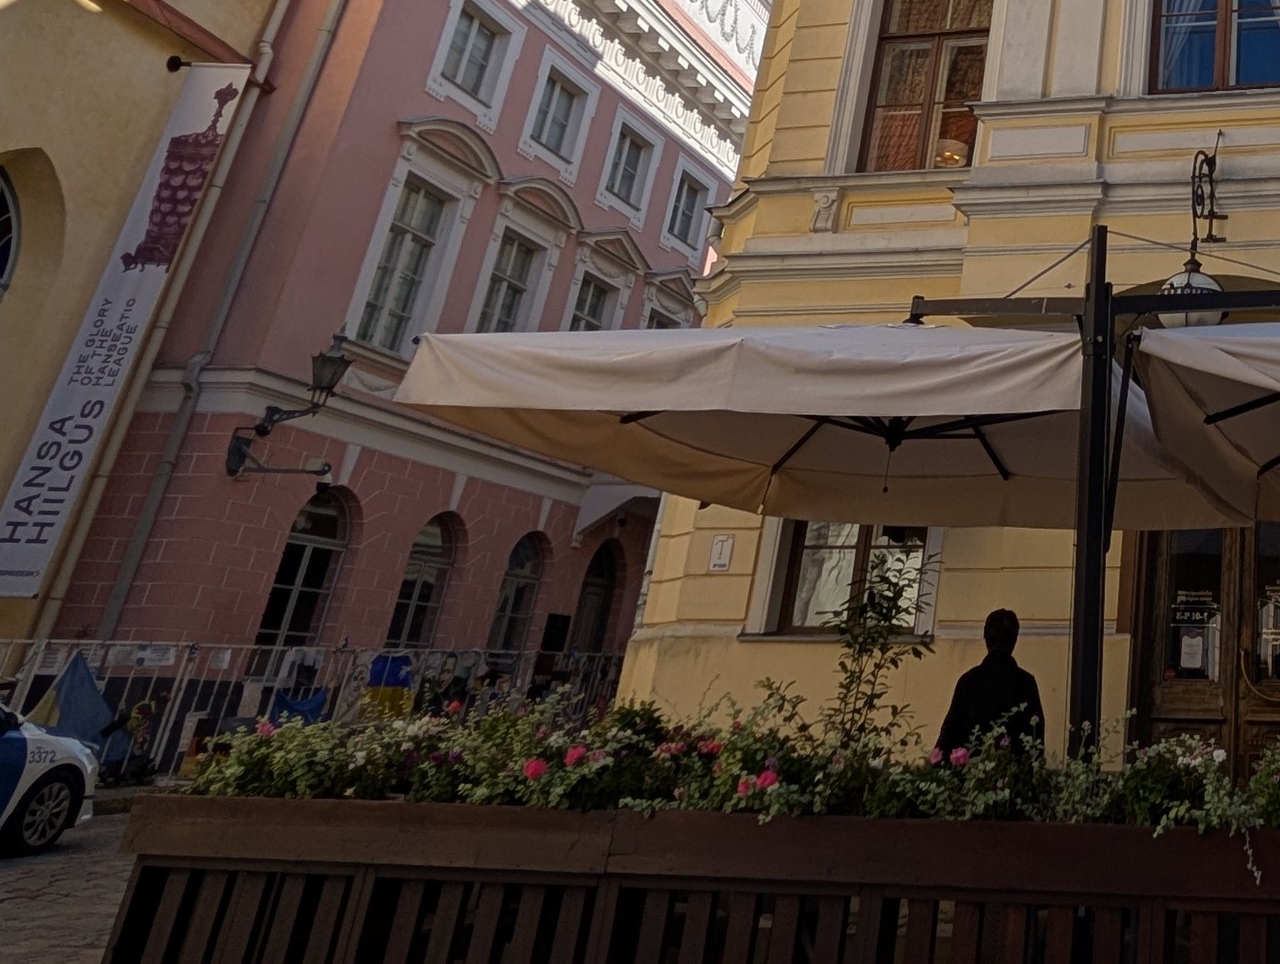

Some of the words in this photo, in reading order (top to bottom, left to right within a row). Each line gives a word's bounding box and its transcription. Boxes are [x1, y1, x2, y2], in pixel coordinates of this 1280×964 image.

[67, 353, 90, 386] THE
[85, 298, 113, 348] GLORY
[80, 365, 95, 386] OF
[90, 327, 114, 359] THE
[103, 324, 138, 387] LEAGUE
[0, 414, 75, 544] HANSA
[25, 399, 105, 545] HIILGUS
[28, 749, 57, 764] 3372
